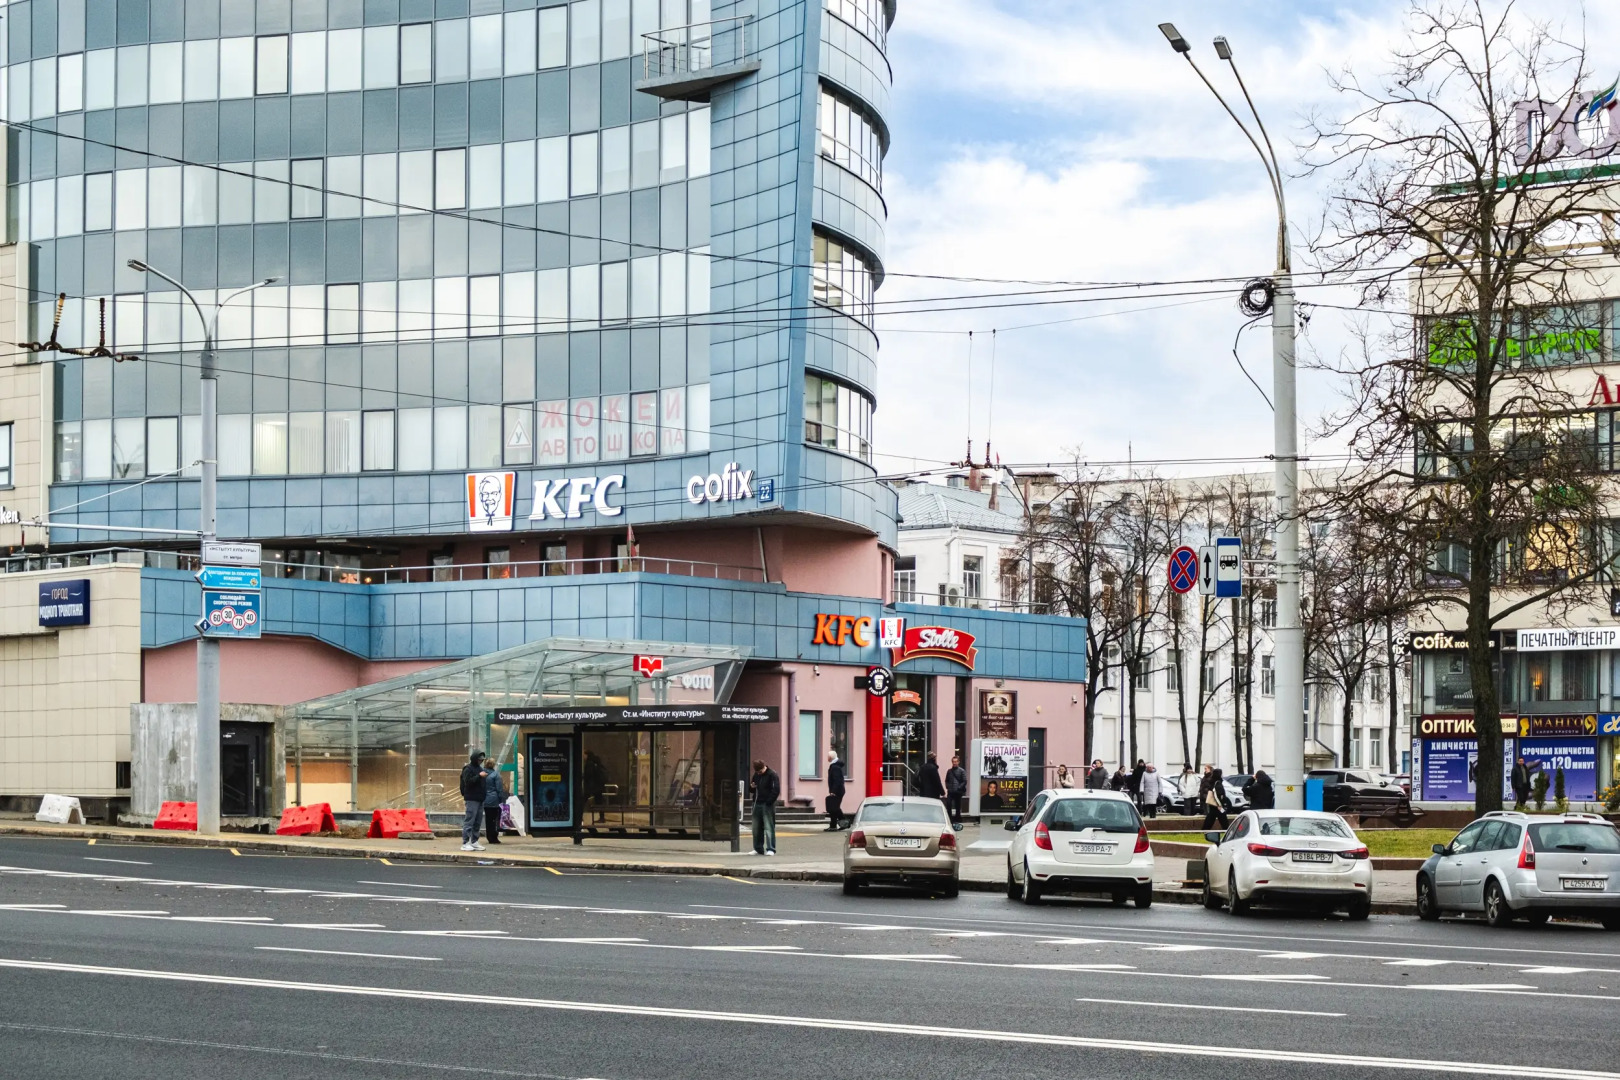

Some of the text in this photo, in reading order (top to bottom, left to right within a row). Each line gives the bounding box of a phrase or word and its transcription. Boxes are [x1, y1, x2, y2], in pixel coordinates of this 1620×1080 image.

[541, 390, 682, 429] ЖОКЕЙ
[540, 429, 684, 457] АВТОШКОЛА
[686, 462, 754, 505] cofix
[528, 474, 625, 521] KFC
[760, 486, 770, 500] 22
[51, 588, 69, 600] ГОРОД
[58, 603, 83, 618] ТРИКОТАЖА
[224, 610, 233, 619] 30
[246, 613, 254, 622] 40
[213, 614, 221, 622] 60
[235, 618, 243, 627] 70
[813, 613, 872, 648] KFC
[918, 628, 959, 650] Stolle
[1413, 632, 1454, 649] cofix
[1521, 630, 1616, 648] ПЕЧАТНЫЙ ЦЕНТР
[681, 674, 713, 690] ФОТО
[499, 712, 526, 720] Станцыя
[545, 712, 574, 720] «Інстытут
[575, 711, 607, 719] культуры»
[622, 709, 705, 718] Ст.м. «Институт культуры»
[1421, 719, 1477, 734] ОПТИК
[1533, 717, 1584, 728] МАНГО
[1431, 741, 1479, 751] ХИМЧИСТКА
[1522, 746, 1595, 756] СРОЧНАЯ ХИМЧИСТКА
[1542, 756, 1595, 770] ЗА 120 МИНУТ
[1000, 781, 1024, 789] LIZER
[1315, 853, 1332, 861] PB-7
